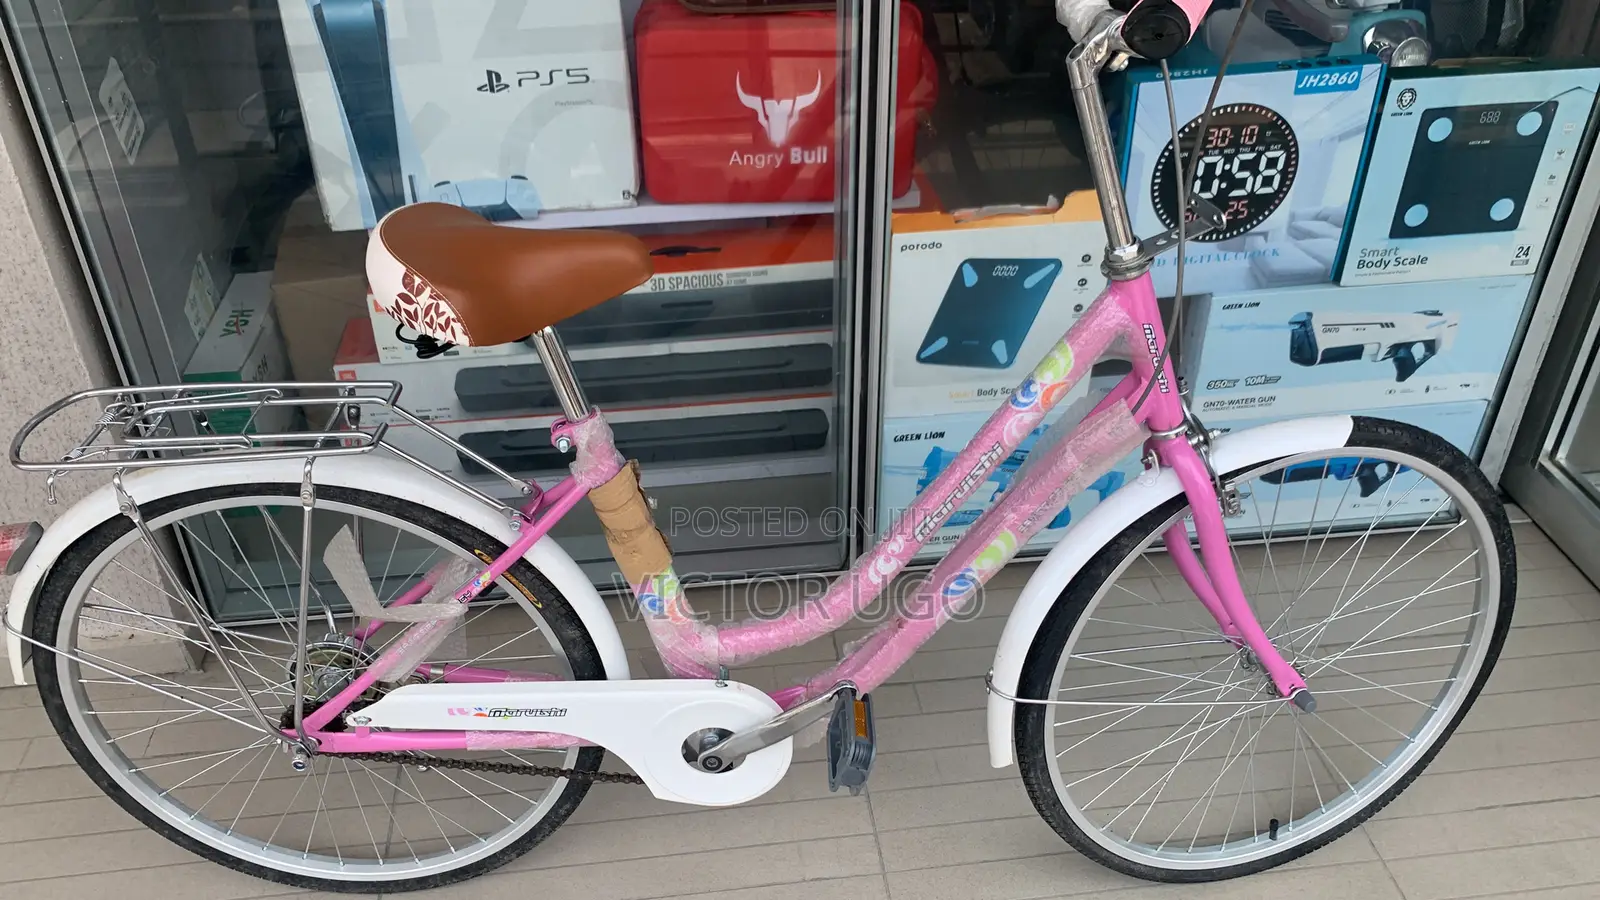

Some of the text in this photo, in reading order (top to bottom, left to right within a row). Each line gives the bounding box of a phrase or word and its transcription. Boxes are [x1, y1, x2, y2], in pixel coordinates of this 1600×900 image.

[516, 67, 590, 88] PS5
[1297, 71, 1359, 88] JH2860
[729, 146, 828, 168] Angry Bull
[900, 241, 943, 252] porodo
[1359, 246, 1400, 259] Smart
[1515, 245, 1531, 259] 24
[1235, 248, 1280, 261] CLOCK
[1356, 254, 1429, 270] Body Scale
[650, 273, 724, 292] 3D SPACIOUS
[1222, 302, 1243, 310] GREEN
[977, 388, 998, 397] Body
[1203, 395, 1277, 409] GN70-WATER GUN
[894, 432, 921, 442] GREEN
[941, 534, 960, 542] GUN
